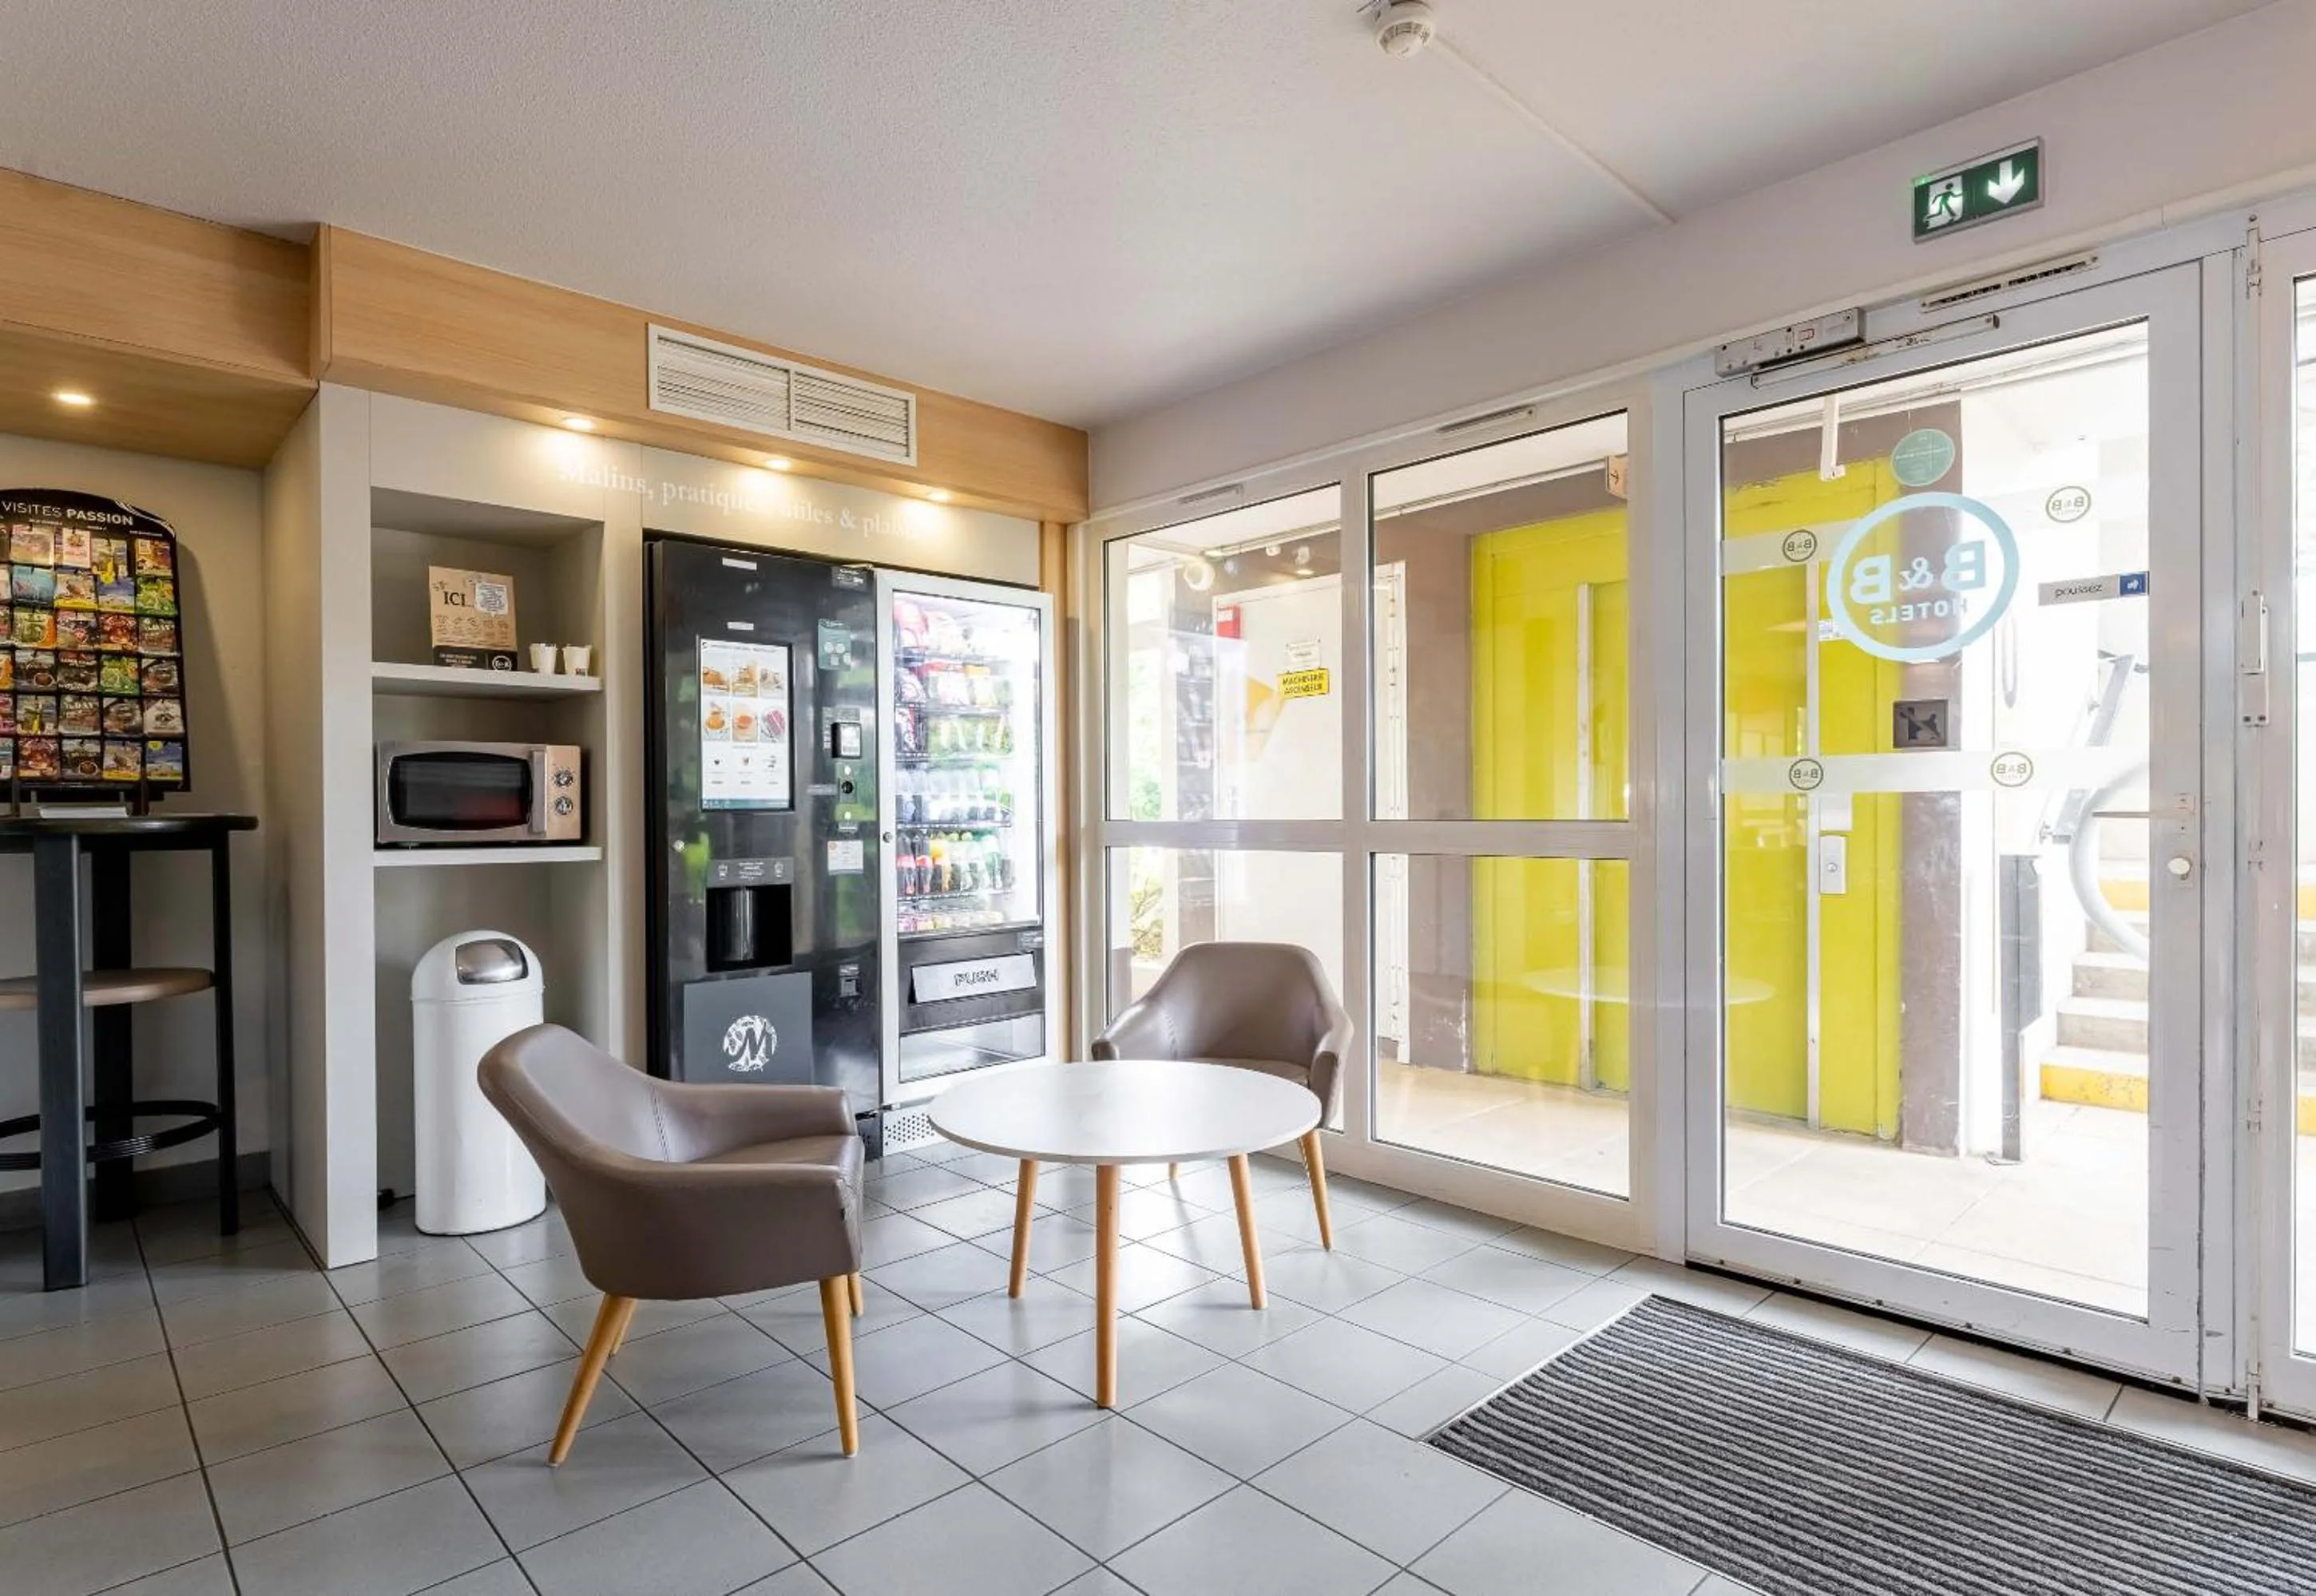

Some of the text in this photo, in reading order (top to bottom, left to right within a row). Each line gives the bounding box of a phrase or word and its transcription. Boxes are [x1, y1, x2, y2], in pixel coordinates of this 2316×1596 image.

[2, 501, 62, 518] VISITES
[66, 508, 134, 526] PASSION
[839, 506, 858, 529] &
